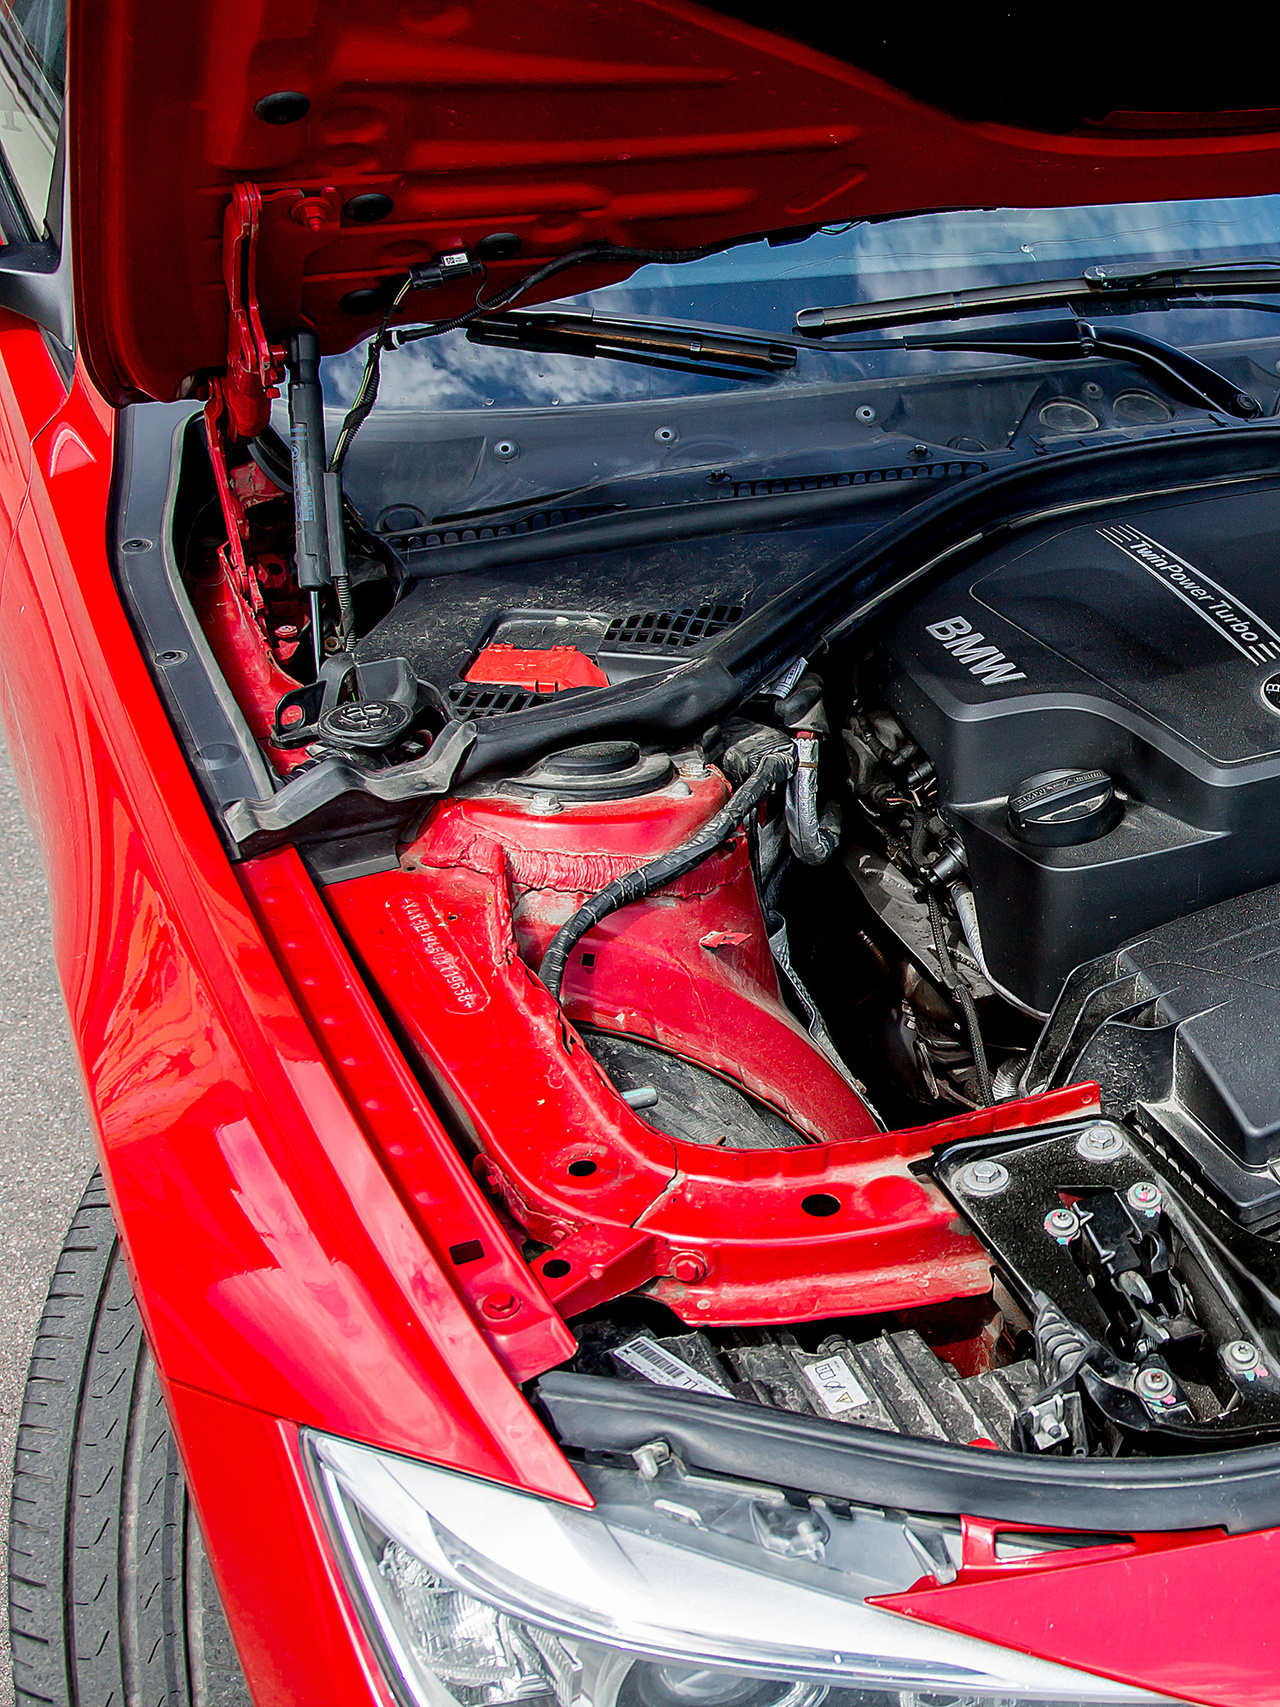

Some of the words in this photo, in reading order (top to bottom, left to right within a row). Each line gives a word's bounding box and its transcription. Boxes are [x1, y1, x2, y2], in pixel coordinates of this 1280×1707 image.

[1129, 540, 1214, 601] TwinPower
[1208, 600, 1259, 641] Turbo
[925, 615, 1028, 686] BMW
